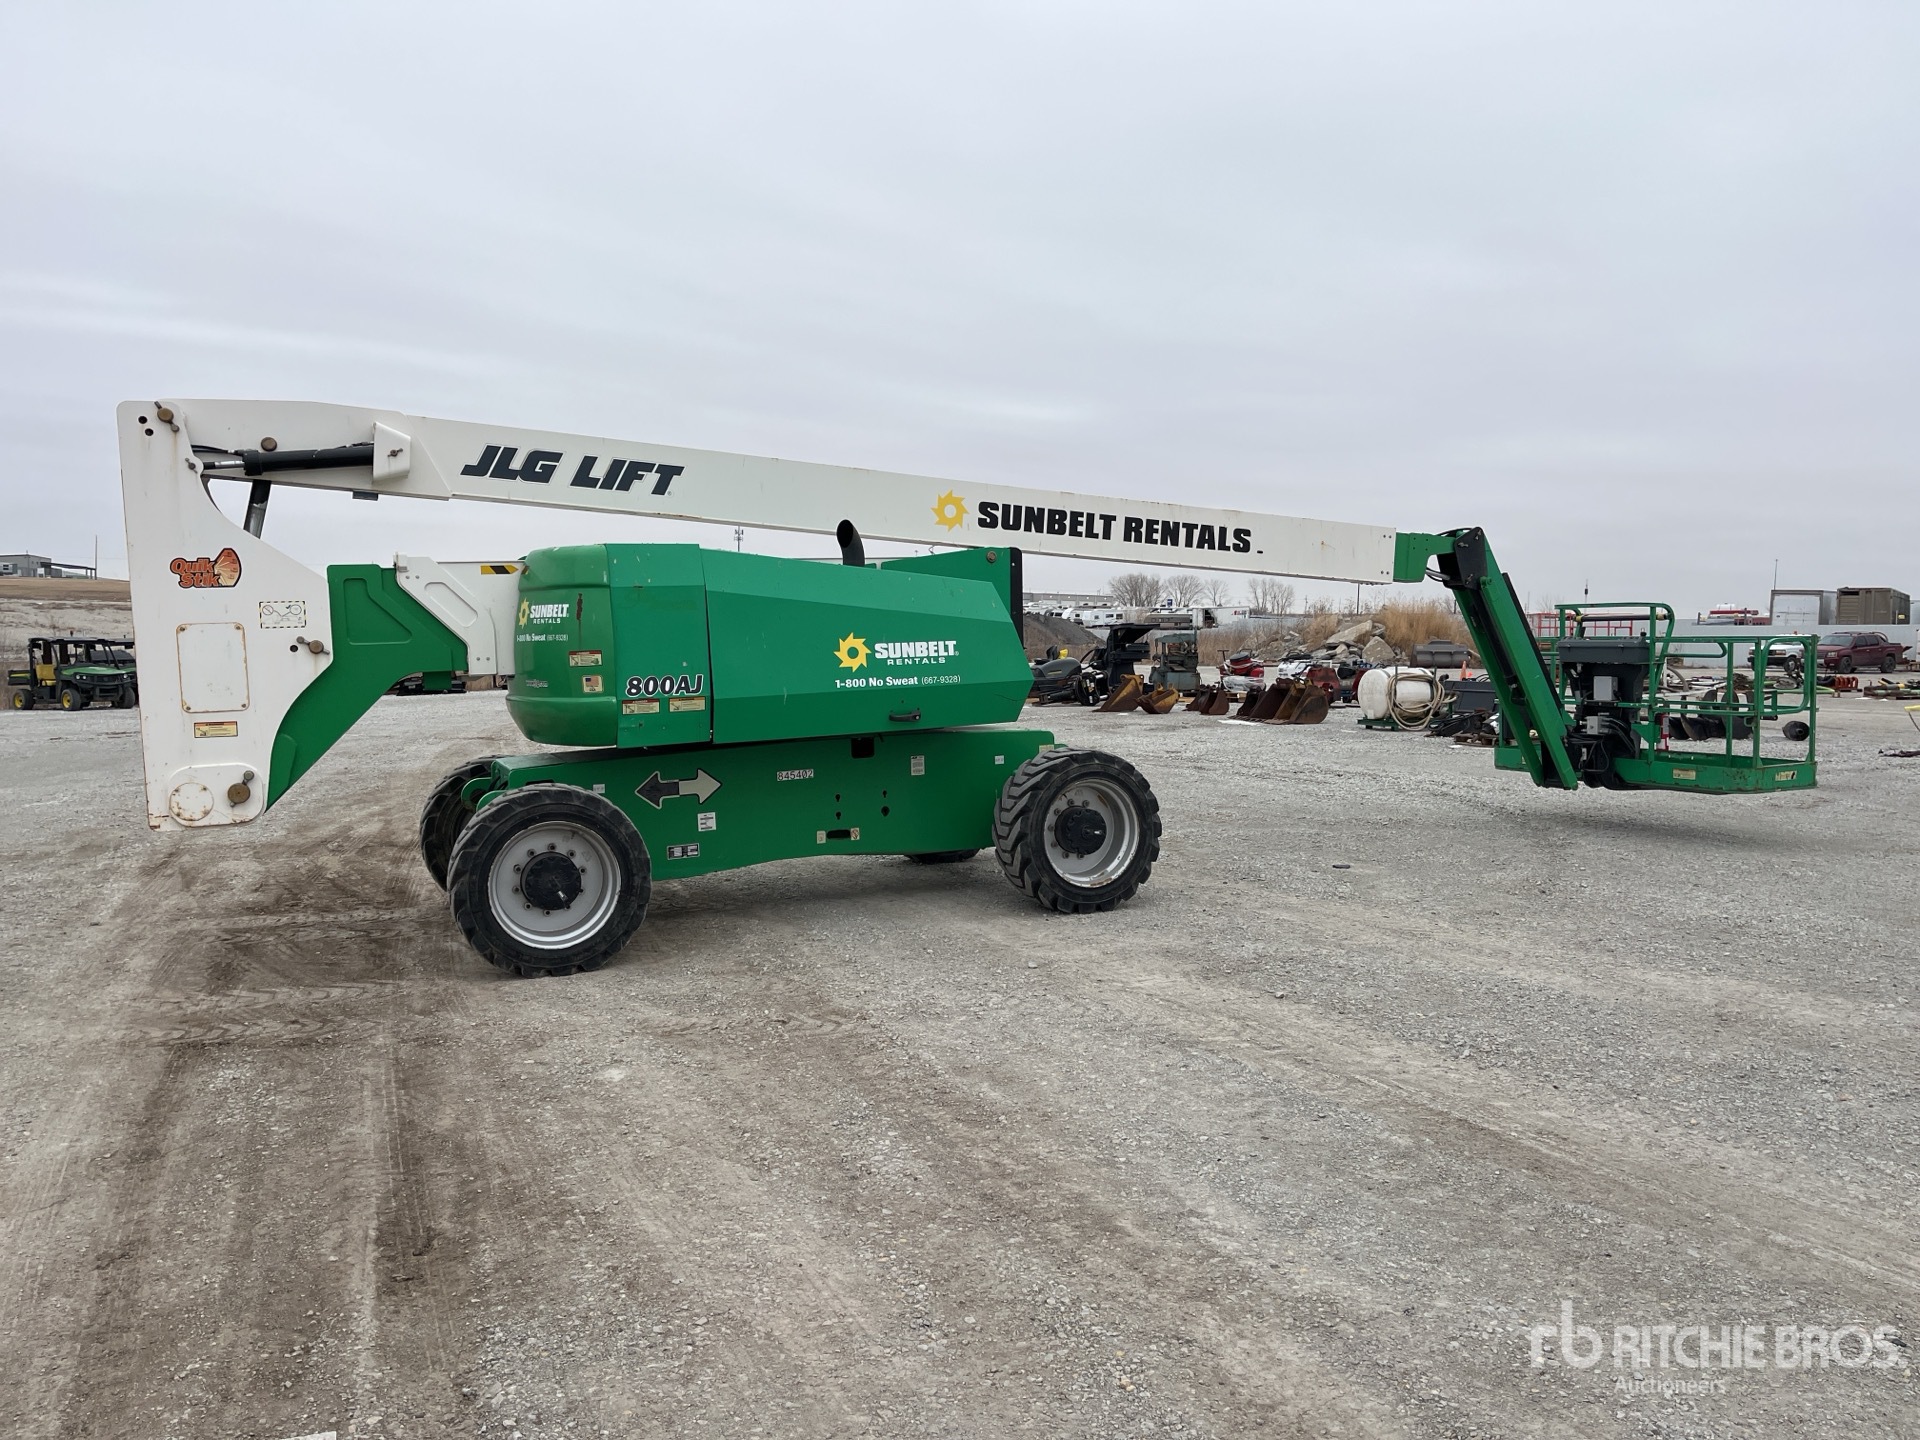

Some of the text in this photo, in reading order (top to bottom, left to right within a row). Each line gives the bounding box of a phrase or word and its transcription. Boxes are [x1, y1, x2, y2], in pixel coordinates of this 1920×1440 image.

[459, 444, 685, 496] JLG LIFT
[977, 501, 1251, 554] SUNBELT RENTALS
[171, 558, 215, 574] Quik
[180, 572, 220, 588] Stik
[530, 604, 569, 618] SUNBELT
[531, 633, 546, 642] Sweat
[874, 640, 957, 659] SUNBELT
[887, 657, 946, 666] RENTALS
[625, 674, 704, 697] 800AJ
[835, 674, 961, 689] 1-800 No Sweat (667-9328)
[777, 769, 813, 781] 845402
